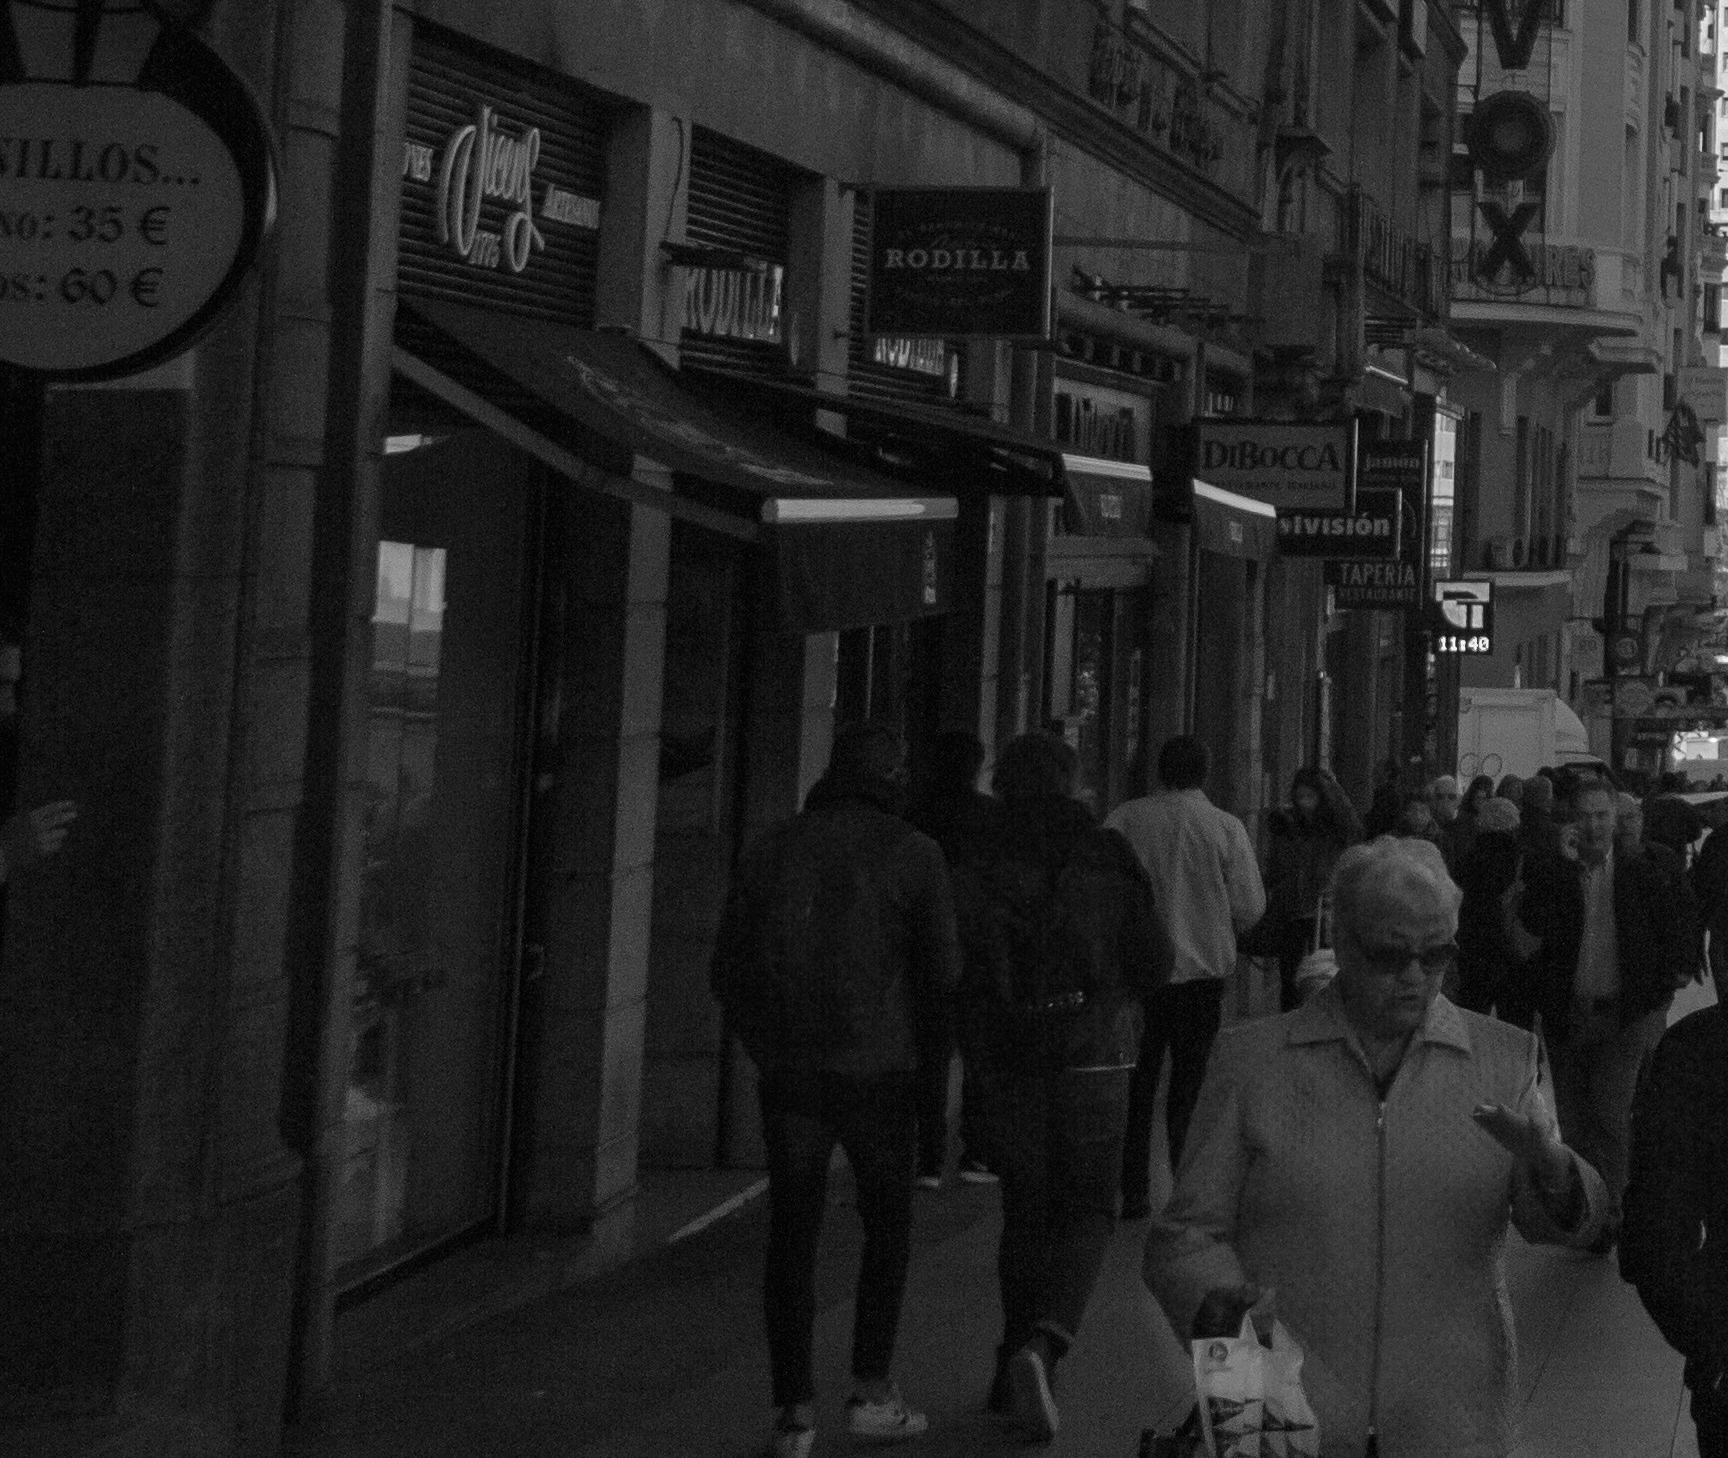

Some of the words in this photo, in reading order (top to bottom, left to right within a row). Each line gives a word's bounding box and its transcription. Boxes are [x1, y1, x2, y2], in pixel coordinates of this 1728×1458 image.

[68, 205, 123, 243] 35
[139, 205, 171, 245] €
[885, 248, 1030, 270] RODILLA
[60, 267, 118, 305] 60
[129, 266, 164, 307] €
[1438, 635, 1490, 653] 11:40
